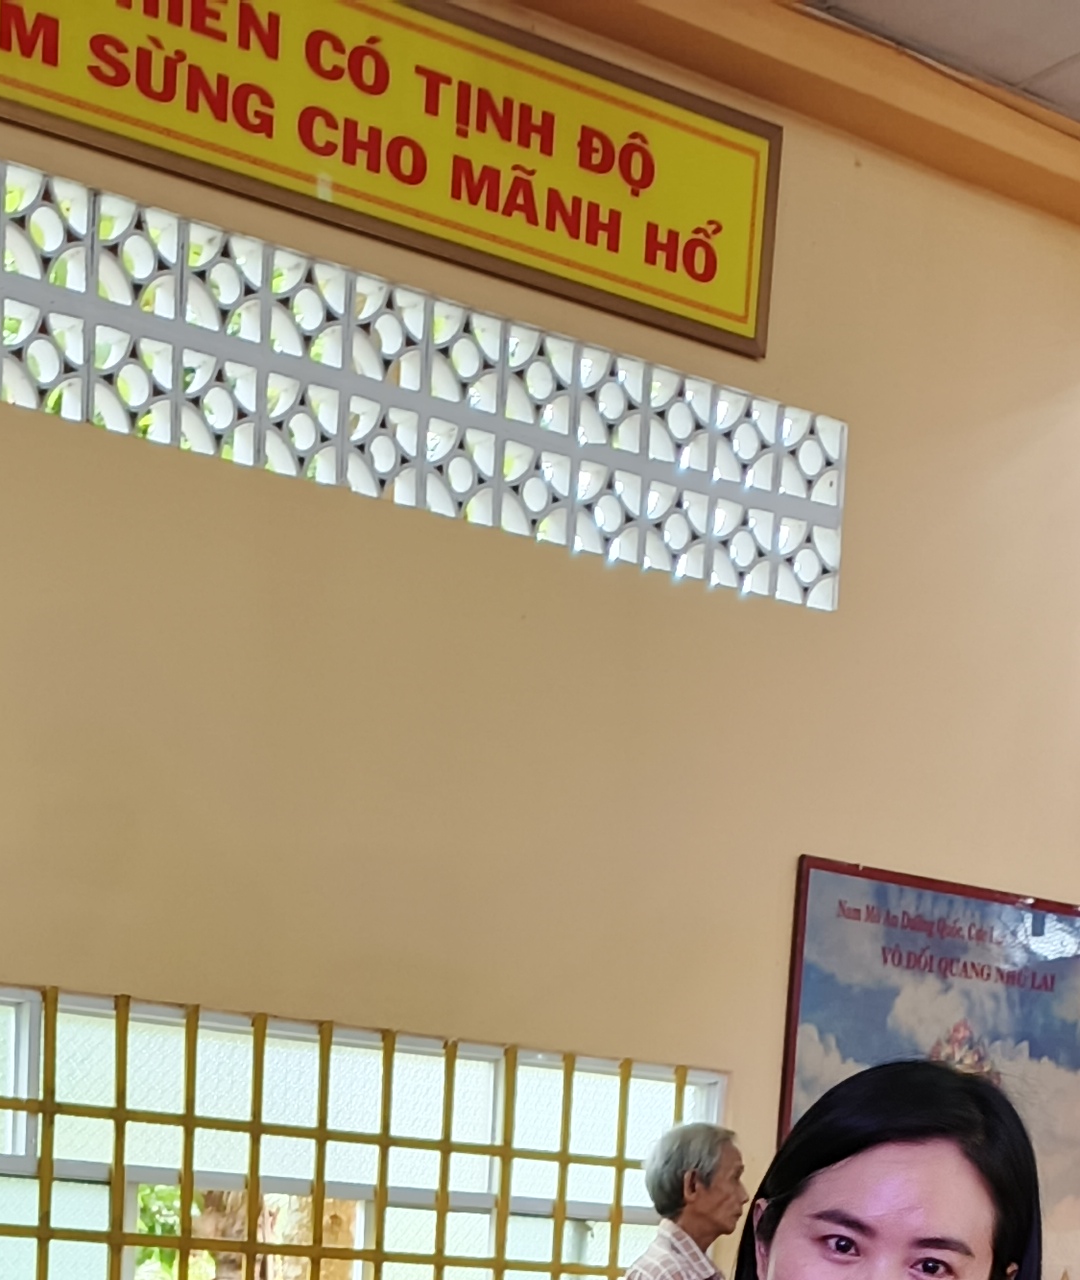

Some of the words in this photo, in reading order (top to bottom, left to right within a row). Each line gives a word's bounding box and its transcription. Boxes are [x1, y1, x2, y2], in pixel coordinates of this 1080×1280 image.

[86, 33, 276, 139] SỪNG
[296, 105, 428, 186] CHO
[449, 153, 622, 254] MÃNH
[643, 219, 724, 284] HỔ
[304, 29, 391, 96] CÓ
[414, 64, 556, 158] TỊNH
[577, 124, 656, 197] ĐỘ
[881, 944, 903, 968] VÔ
[937, 956, 992, 982] QUANG
[1030, 971, 1057, 993] LAI
